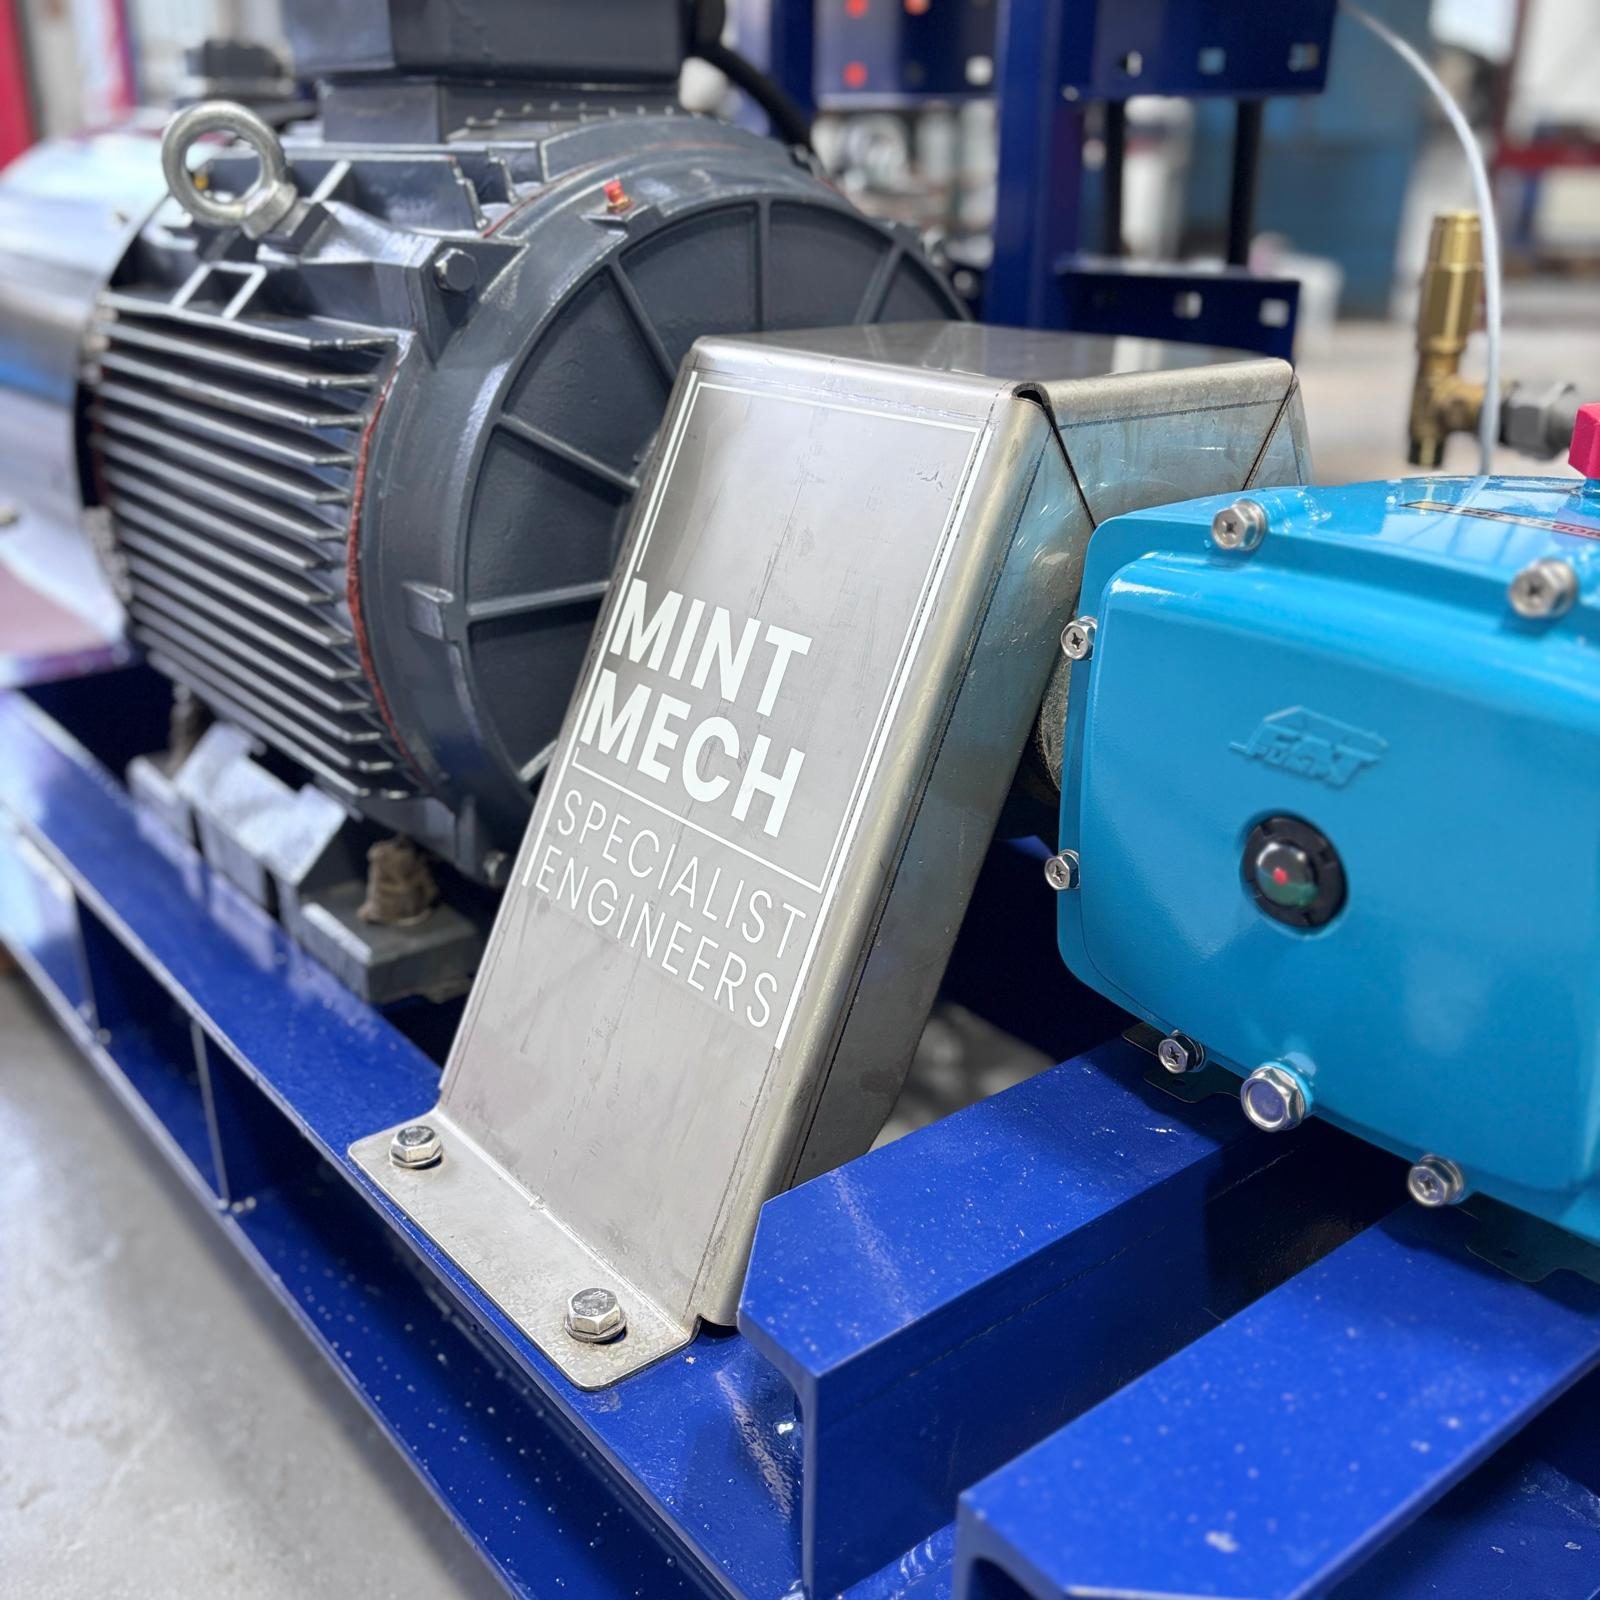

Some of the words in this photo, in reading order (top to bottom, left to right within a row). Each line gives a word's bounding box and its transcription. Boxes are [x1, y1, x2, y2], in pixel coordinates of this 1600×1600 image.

[610, 578, 812, 717] MINT
[580, 669, 806, 838] MECH
[535, 845, 778, 1028] ENGINEERS
[557, 789, 807, 959] SPECIALIST
